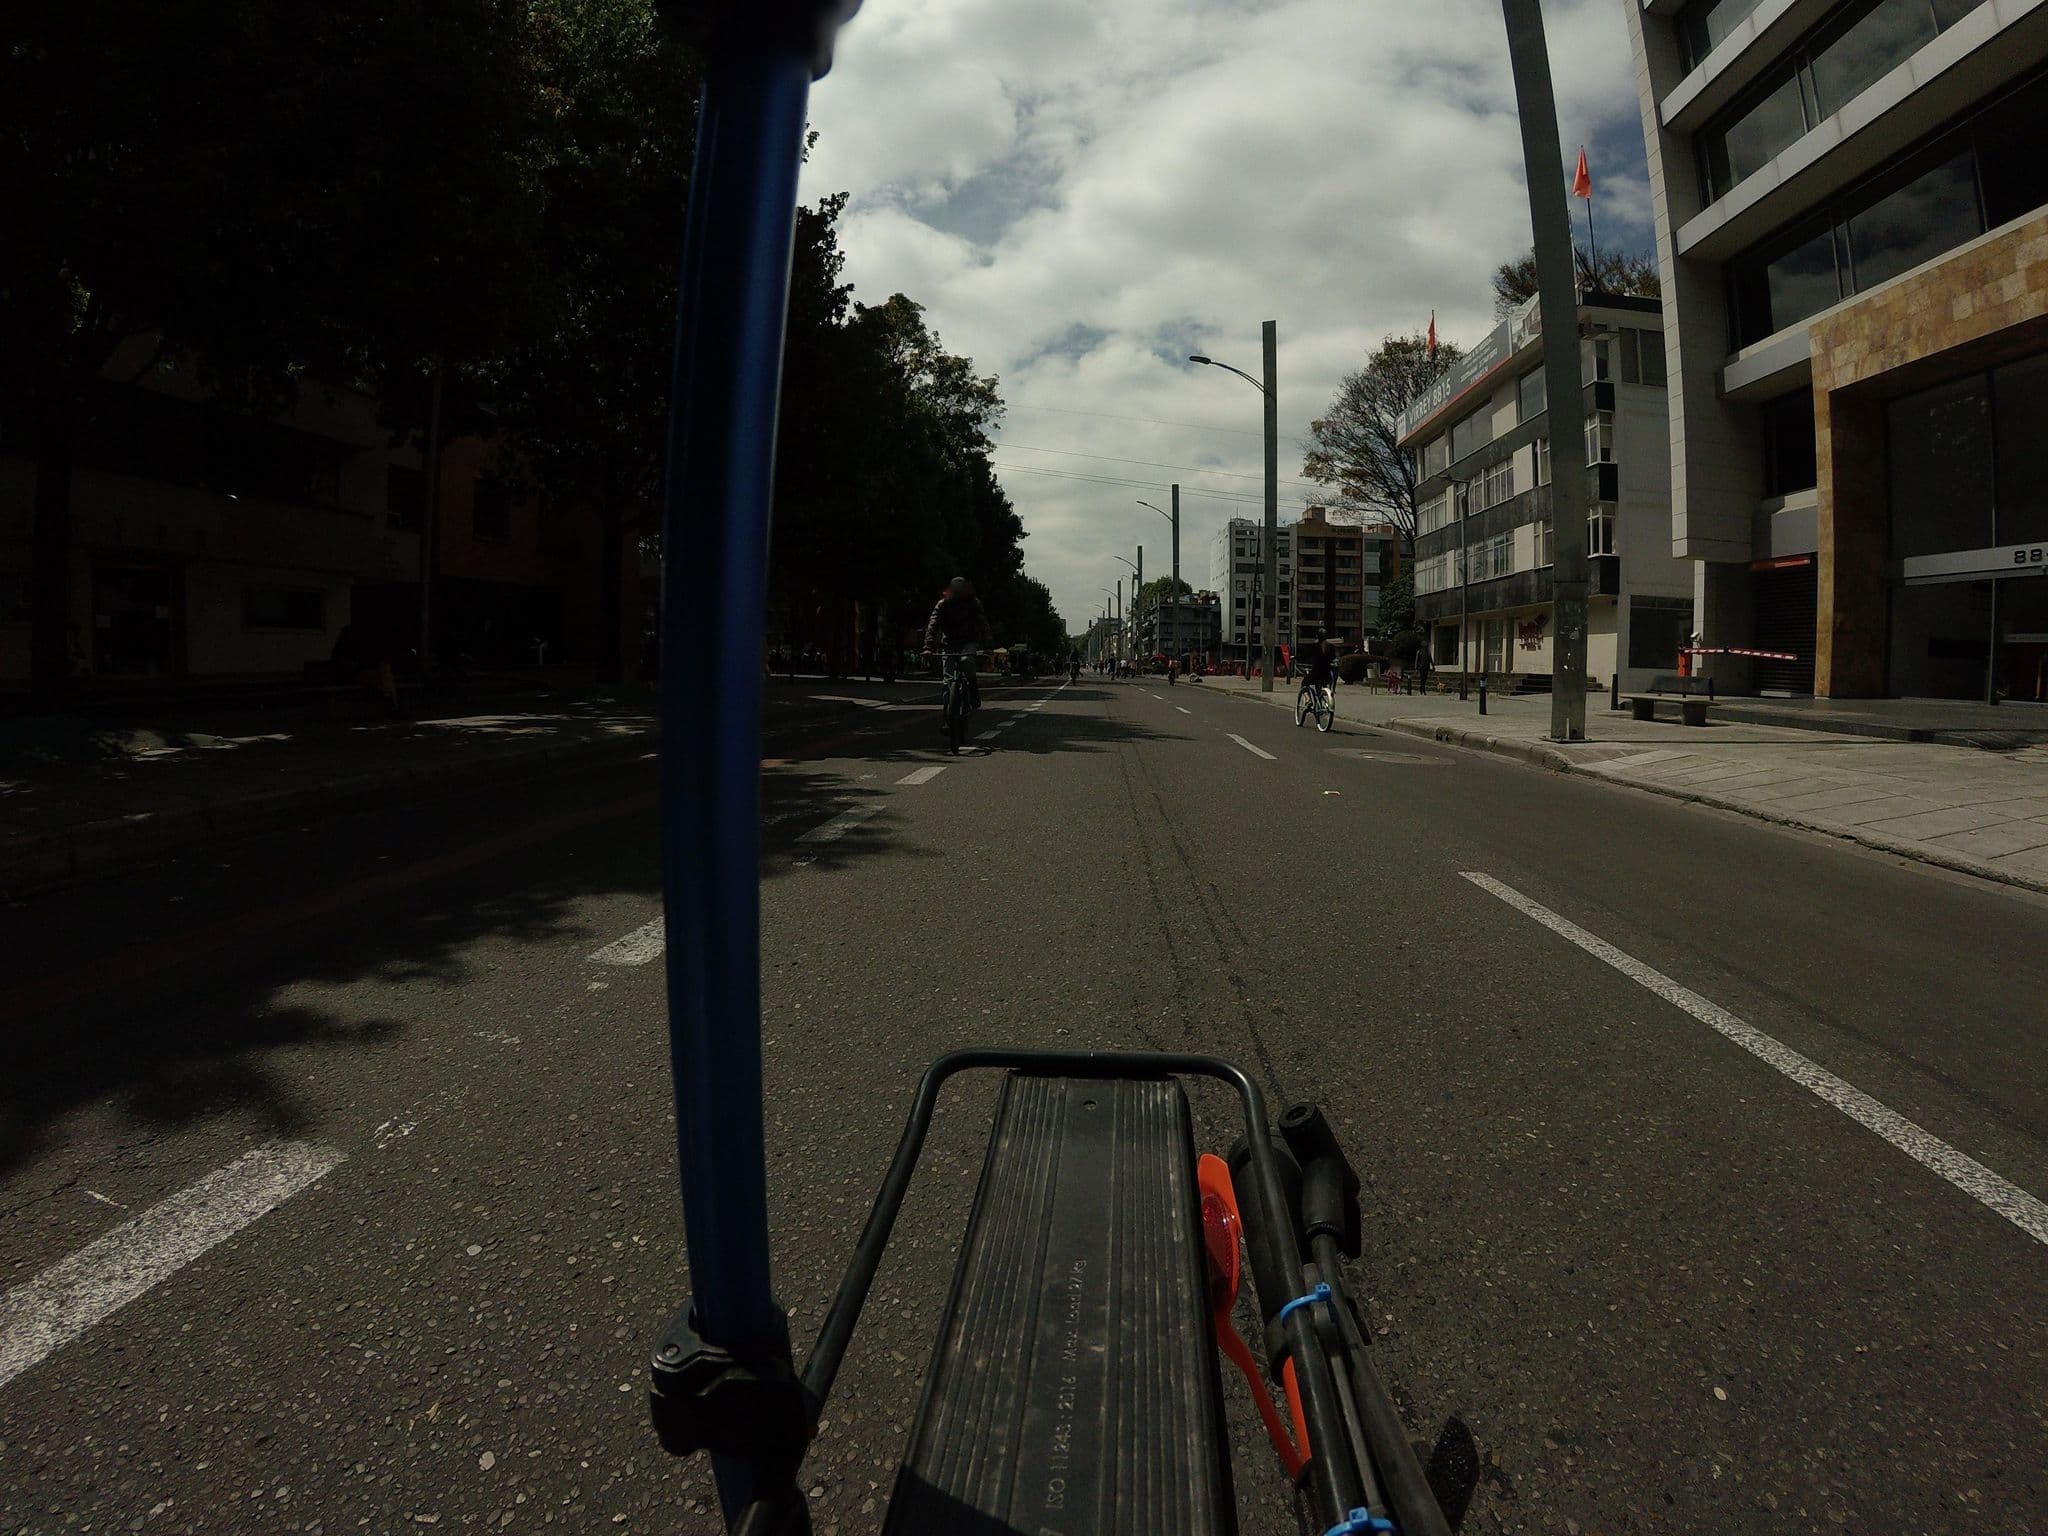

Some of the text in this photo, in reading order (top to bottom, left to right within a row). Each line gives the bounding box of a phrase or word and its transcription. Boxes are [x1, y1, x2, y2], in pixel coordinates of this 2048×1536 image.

[1409, 394, 1431, 424] VIRREY
[1433, 378, 1451, 406] 8815
[1046, 1478, 1065, 1509] ISO
